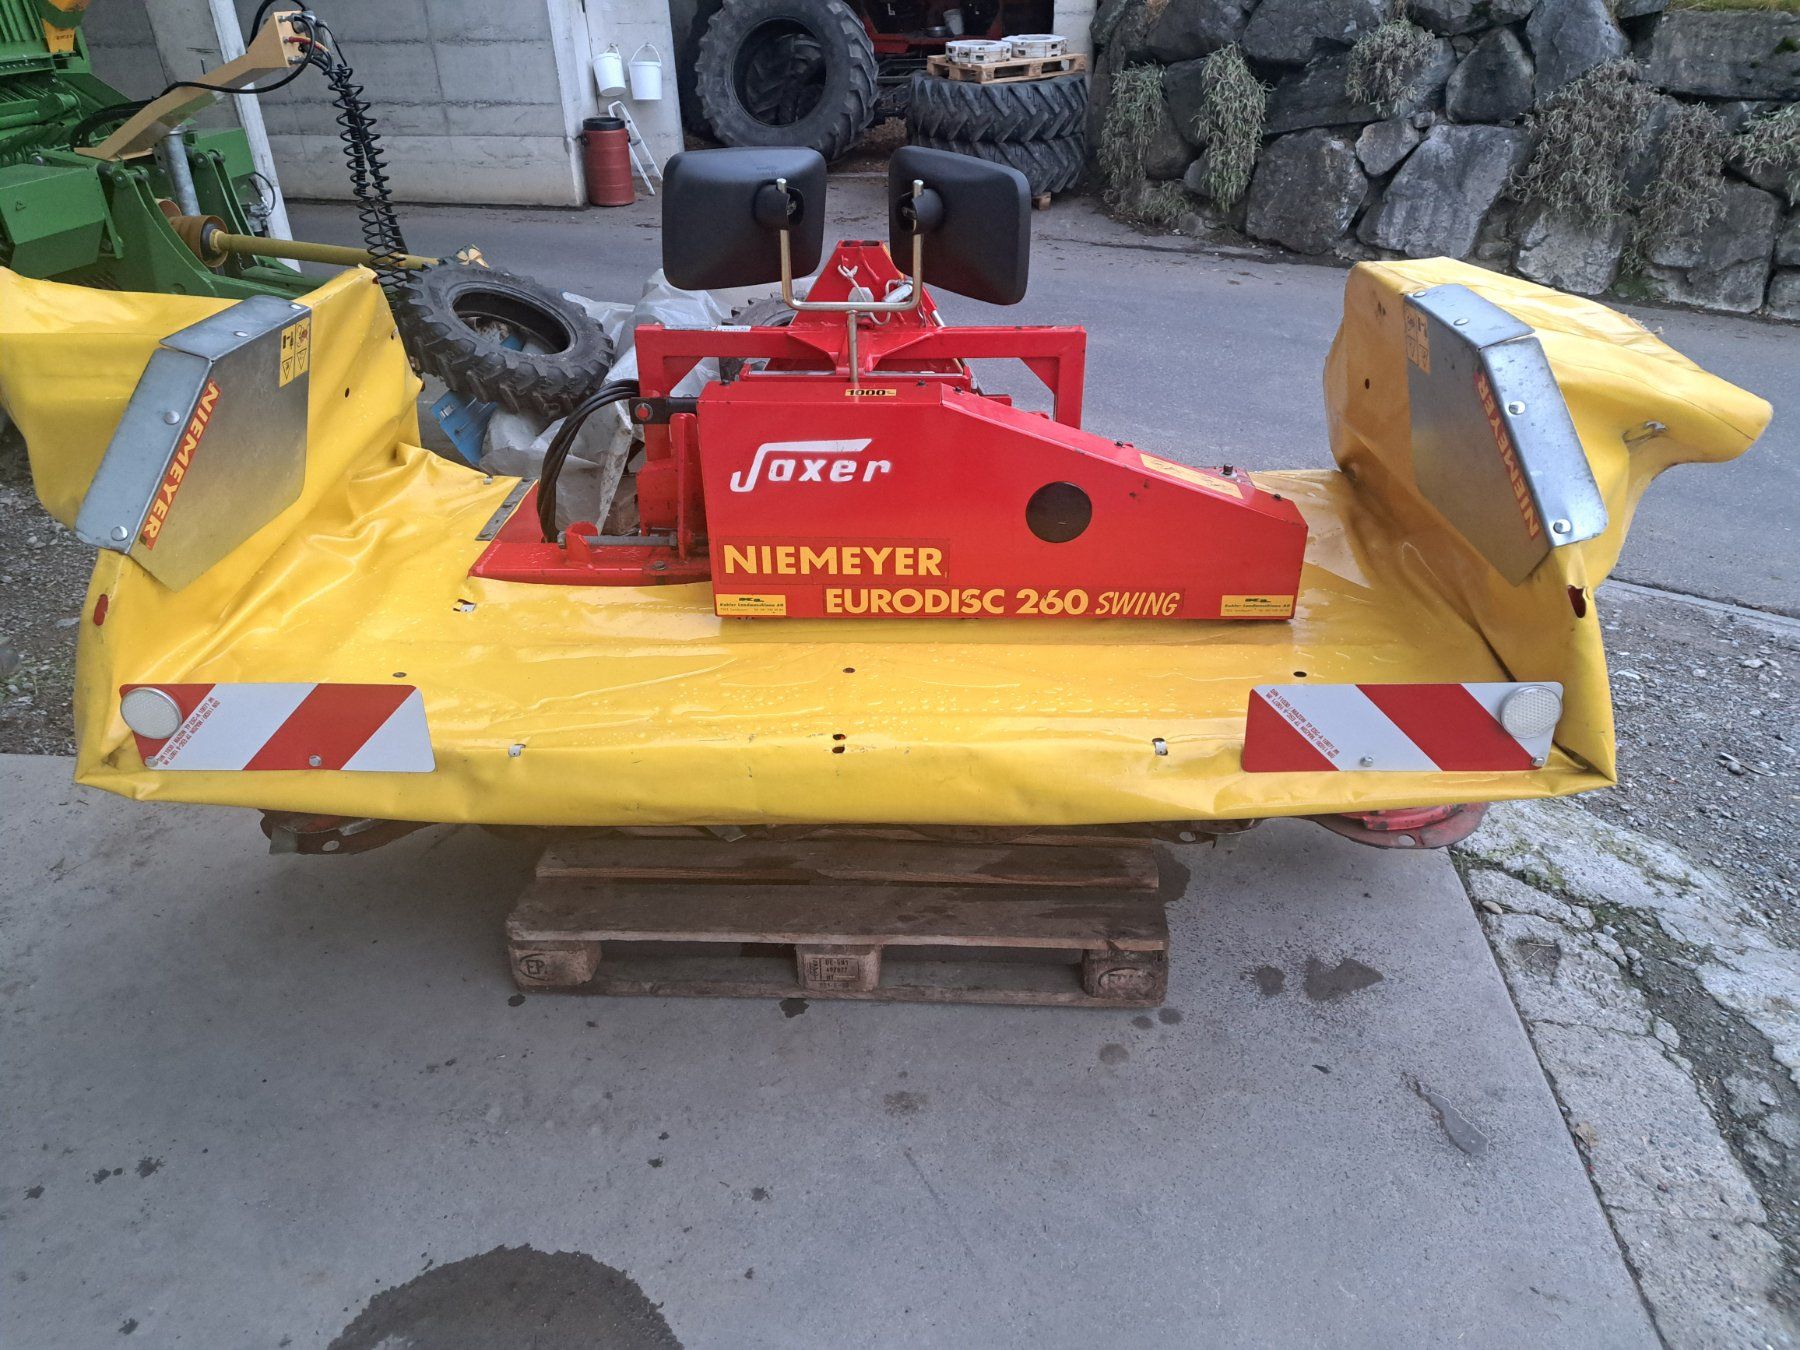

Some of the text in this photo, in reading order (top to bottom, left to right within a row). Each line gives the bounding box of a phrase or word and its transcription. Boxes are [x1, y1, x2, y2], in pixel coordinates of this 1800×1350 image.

[143, 380, 220, 539] NIEMEYER
[1476, 374, 1539, 537] NIEMEYER
[723, 544, 944, 577] NIEMEYER
[825, 588, 1182, 617] EURODISC 260 SWING
